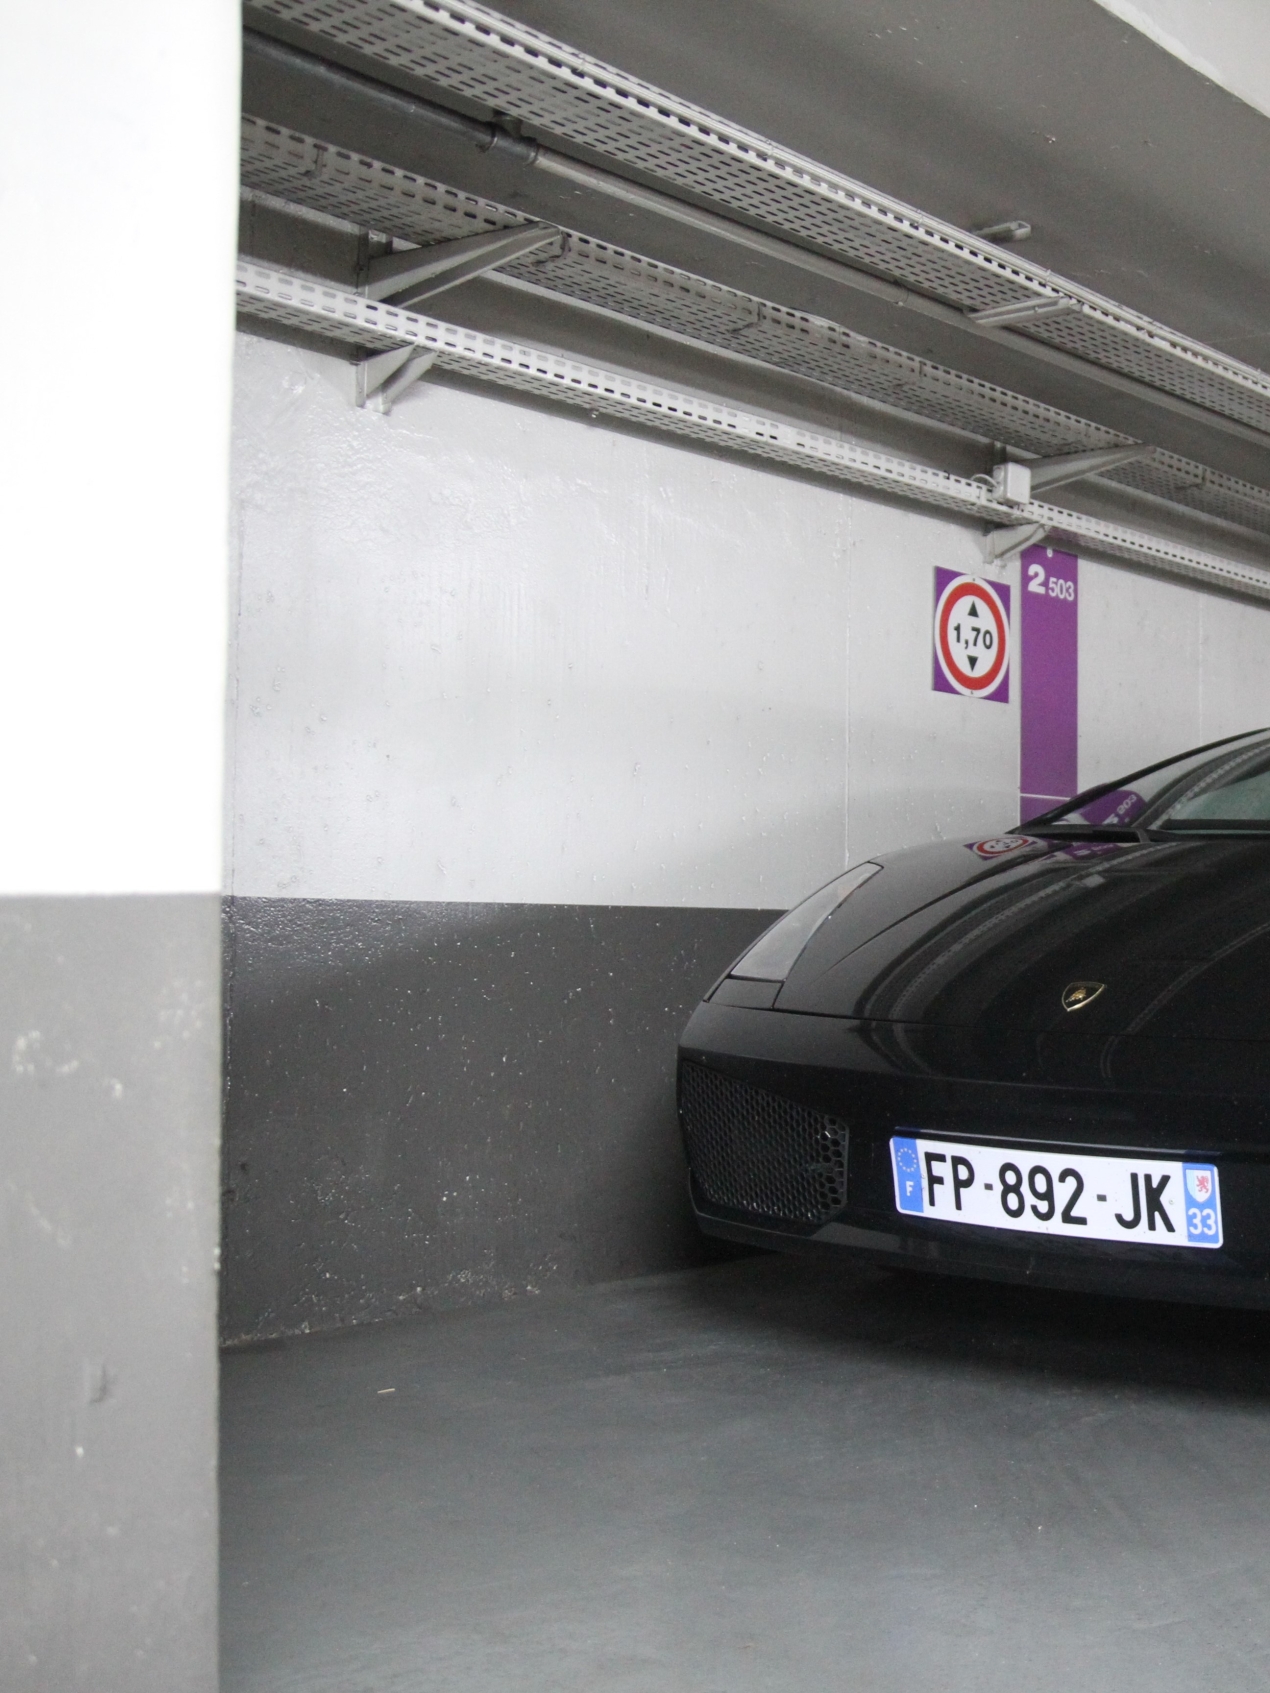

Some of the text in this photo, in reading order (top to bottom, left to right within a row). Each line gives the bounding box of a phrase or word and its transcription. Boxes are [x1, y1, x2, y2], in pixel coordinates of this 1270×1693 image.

[1027, 563, 1075, 601] 2 503
[953, 622, 994, 650] 1,70
[905, 1181, 914, 1196] F
[923, 1150, 1176, 1233] FP-892-JK
[1187, 1207, 1216, 1236] 33
